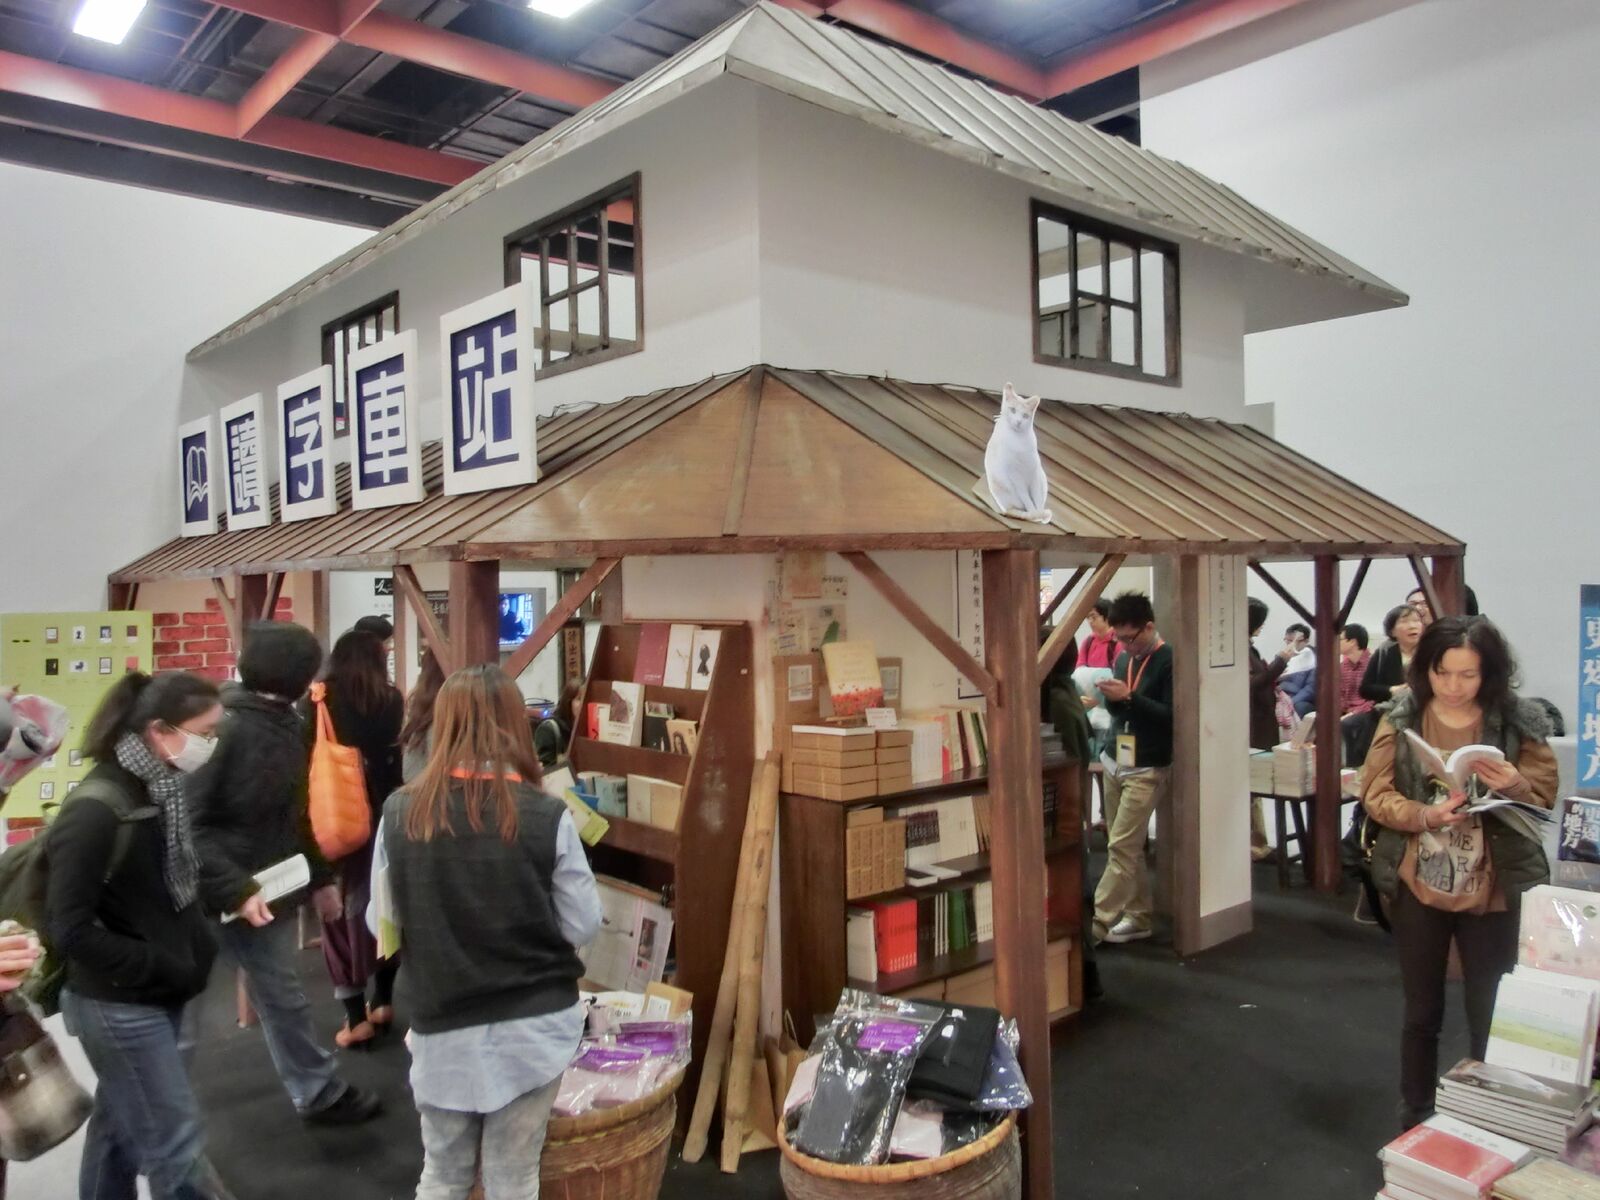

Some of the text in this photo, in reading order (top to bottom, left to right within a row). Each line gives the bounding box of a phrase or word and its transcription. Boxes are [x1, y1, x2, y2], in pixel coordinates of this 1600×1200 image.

[231, 326, 519, 511] 讀字車站
[1449, 831, 1473, 851] ME
[1562, 803, 1584, 849] 的地方
